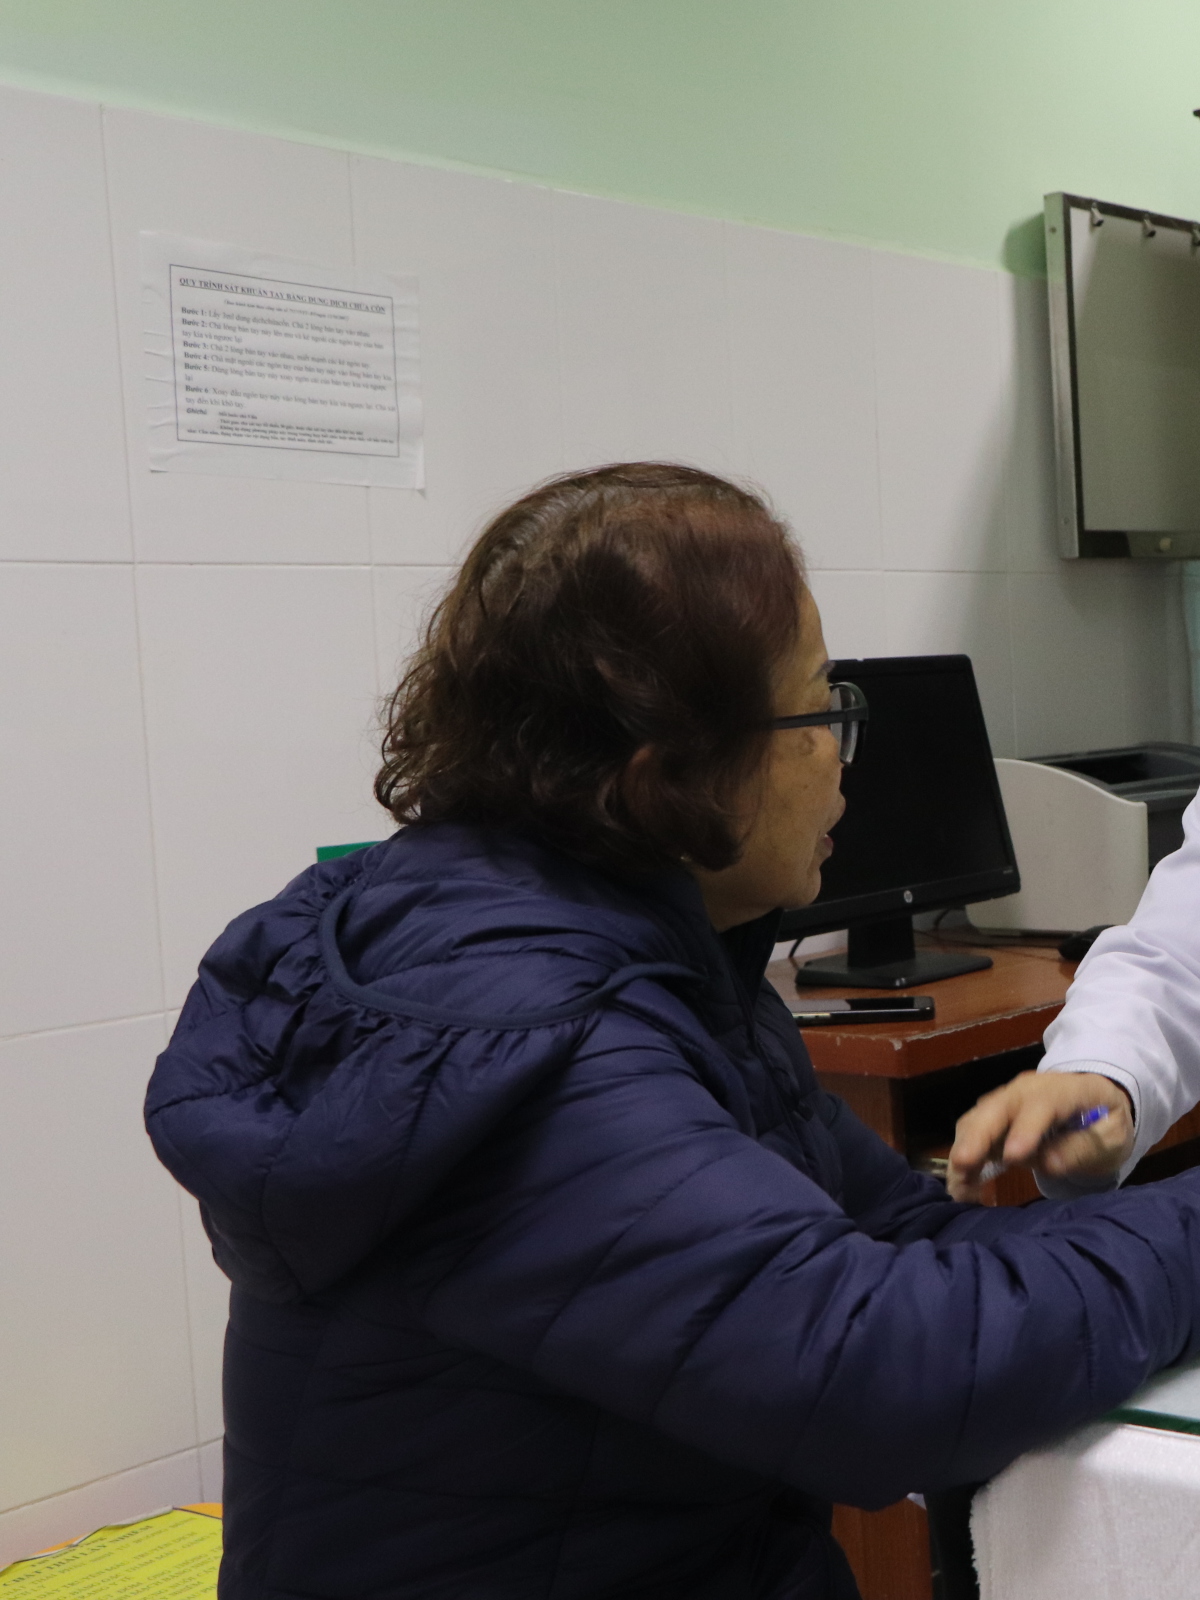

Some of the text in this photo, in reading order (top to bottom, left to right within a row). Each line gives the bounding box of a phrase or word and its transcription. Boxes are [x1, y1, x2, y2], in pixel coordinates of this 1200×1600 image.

[179, 277, 196, 286] QUY
[199, 279, 223, 290] TRÌNH
[270, 290, 284, 299] TAY
[181, 307, 199, 316] Bước
[182, 318, 200, 327] Bước
[183, 340, 201, 349] Bước
[184, 351, 202, 360] Bước
[185, 363, 202, 371] Bước
[186, 385, 203, 393] Bước
